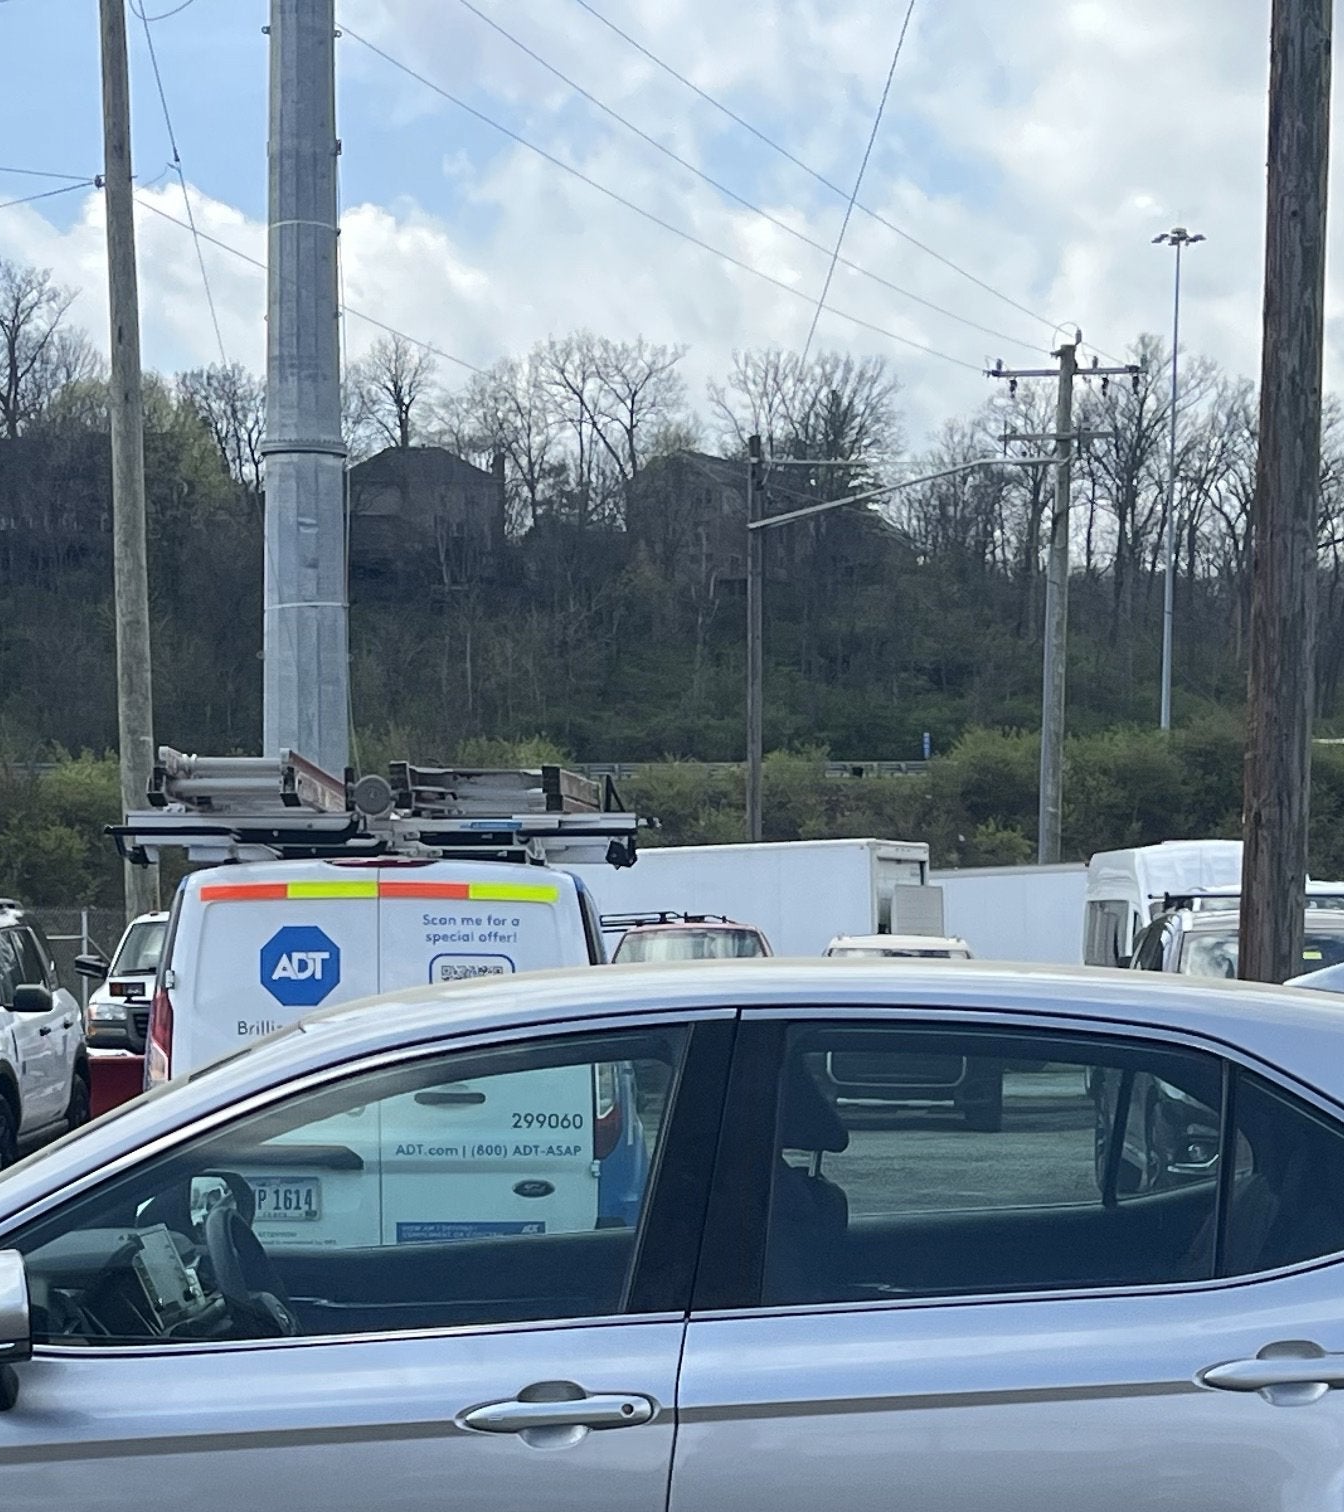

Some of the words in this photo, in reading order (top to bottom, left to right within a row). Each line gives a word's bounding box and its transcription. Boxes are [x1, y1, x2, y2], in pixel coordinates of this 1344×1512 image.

[422, 914, 456, 926] Scan
[461, 916, 483, 926] me
[487, 914, 505, 926] for
[511, 917, 520, 926] a
[425, 930, 474, 945] special
[478, 931, 518, 943] offer!
[271, 951, 331, 980] ADT
[237, 1020, 283, 1036] Brilli
[512, 1113, 584, 1129] 299060
[395, 1144, 458, 1157] ADT.com
[471, 1144, 508, 1159] (800)
[512, 1145, 582, 1157] ADT-ASAP
[273, 1189, 313, 1210] 1614
